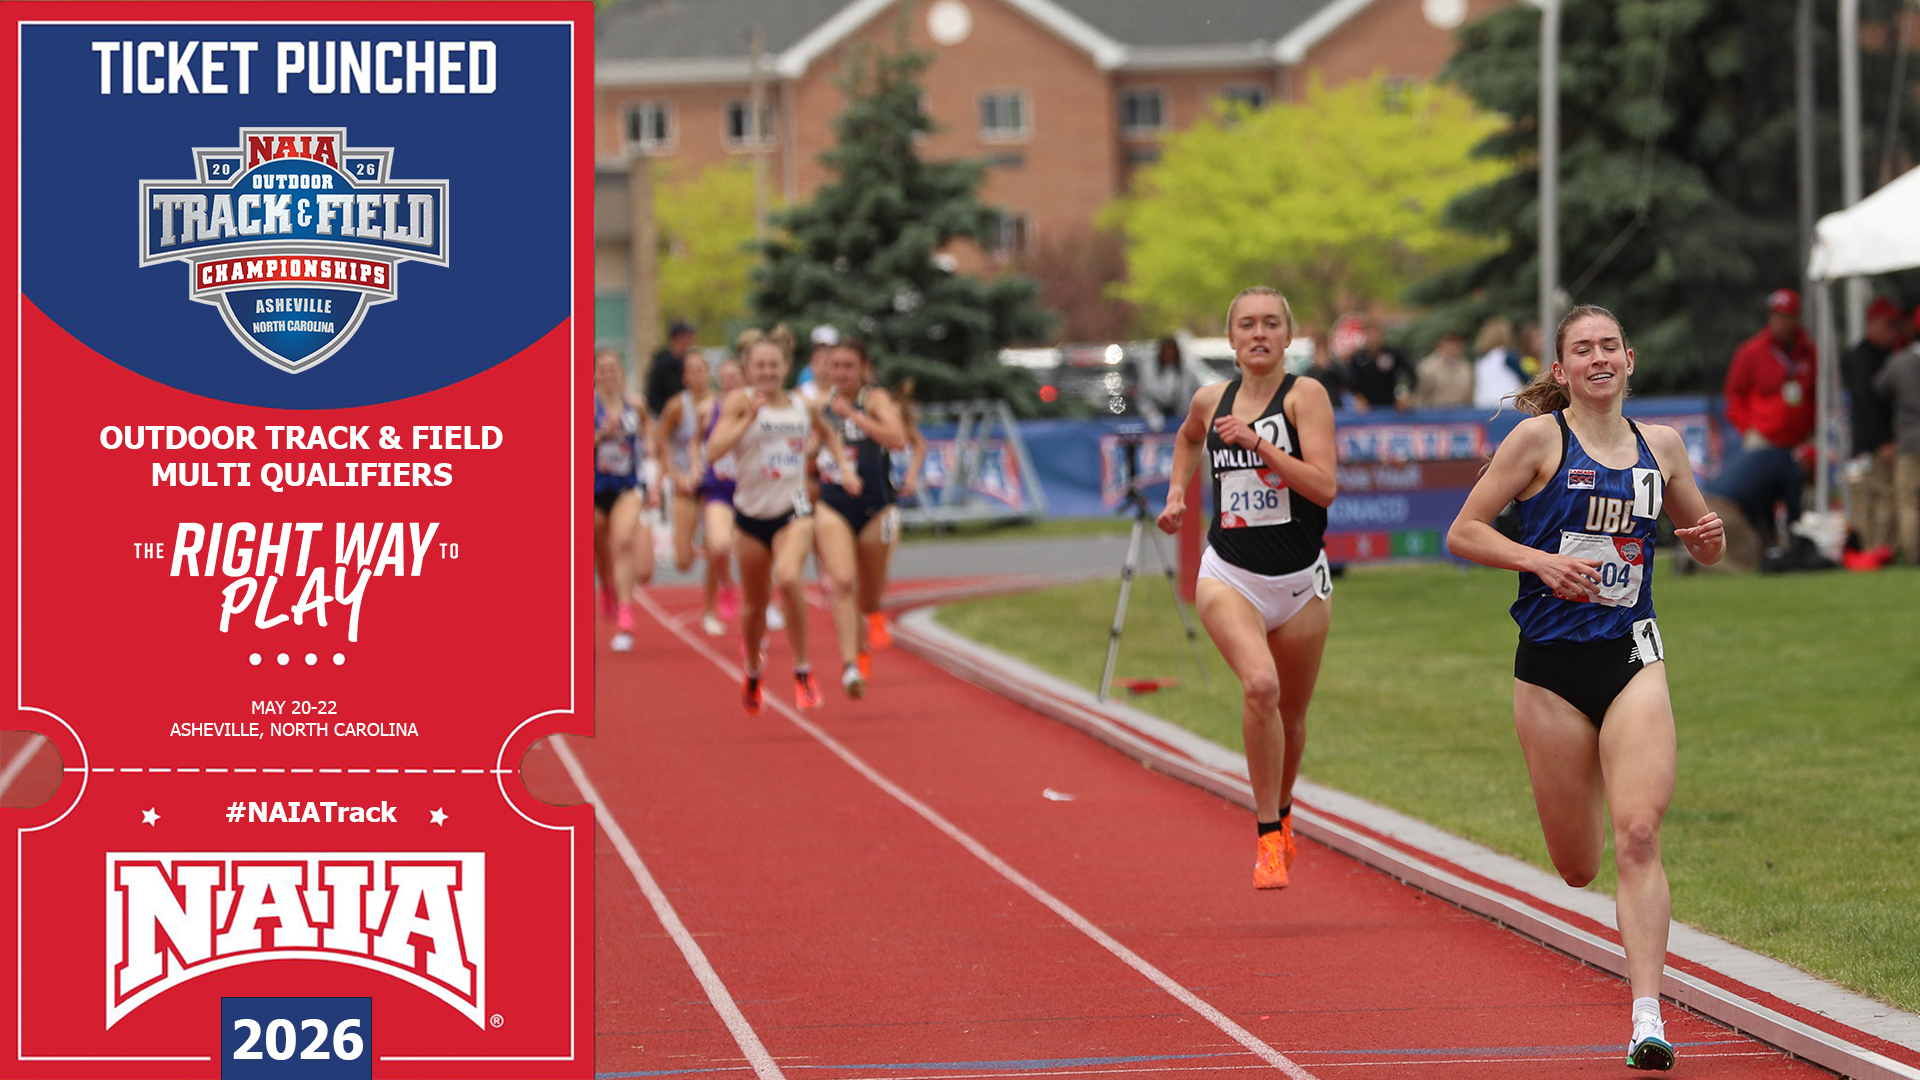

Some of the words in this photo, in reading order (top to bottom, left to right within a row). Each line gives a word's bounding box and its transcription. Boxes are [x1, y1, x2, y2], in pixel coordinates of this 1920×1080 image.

[1262, 420, 1286, 453] 2
[1570, 475, 1593, 484] CCC
[1641, 472, 1654, 516] 1
[1230, 489, 1279, 512] 2136
[1585, 496, 1637, 534] UBC
[1315, 564, 1331, 597] 2
[1641, 621, 1660, 661] 1
